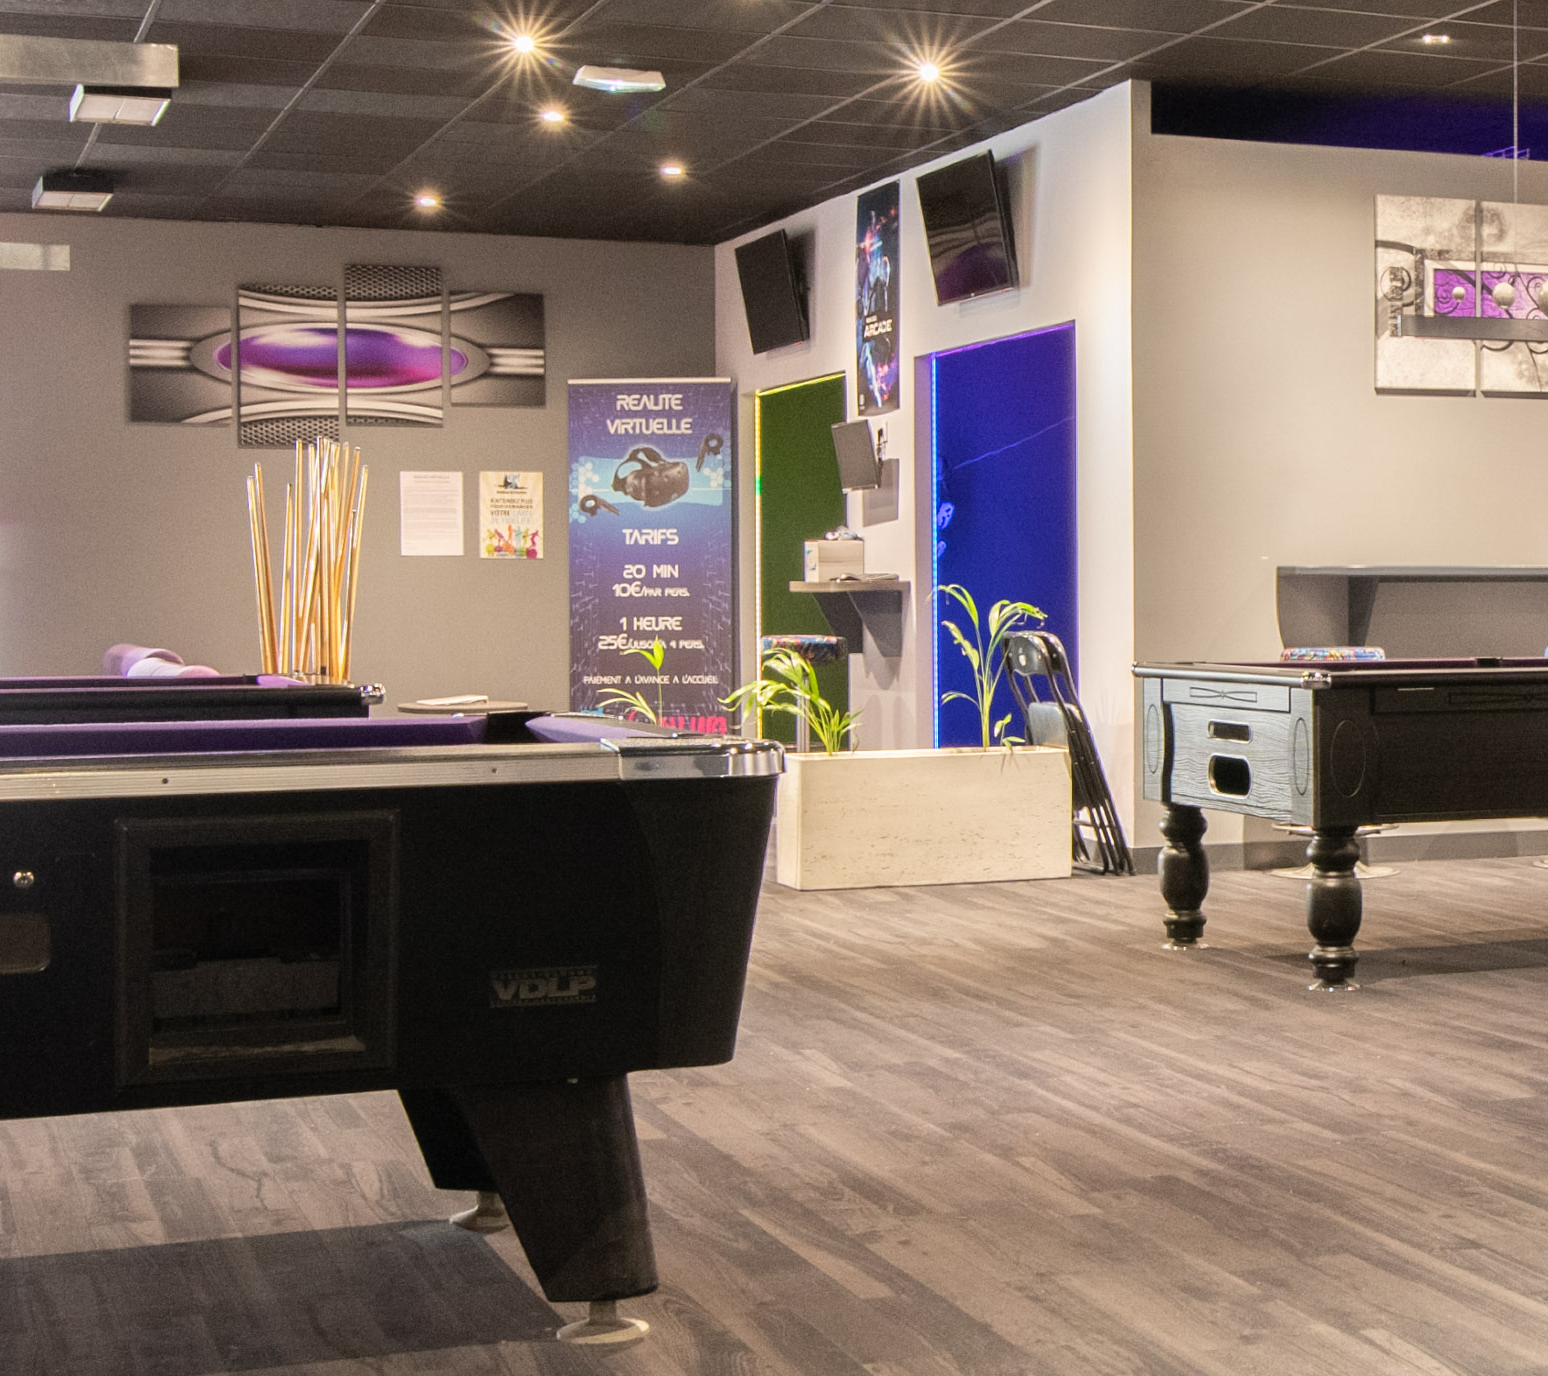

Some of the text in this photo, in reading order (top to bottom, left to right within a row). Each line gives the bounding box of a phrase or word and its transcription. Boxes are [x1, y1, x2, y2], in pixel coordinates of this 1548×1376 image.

[864, 319, 893, 337] ARCADE
[607, 418, 693, 434] VIRTUELLE
[621, 528, 679, 545] TARIFS
[623, 564, 679, 579] 20 MIN
[620, 616, 682, 631] 1 HEURE
[583, 675, 622, 684] PAIEMENT
